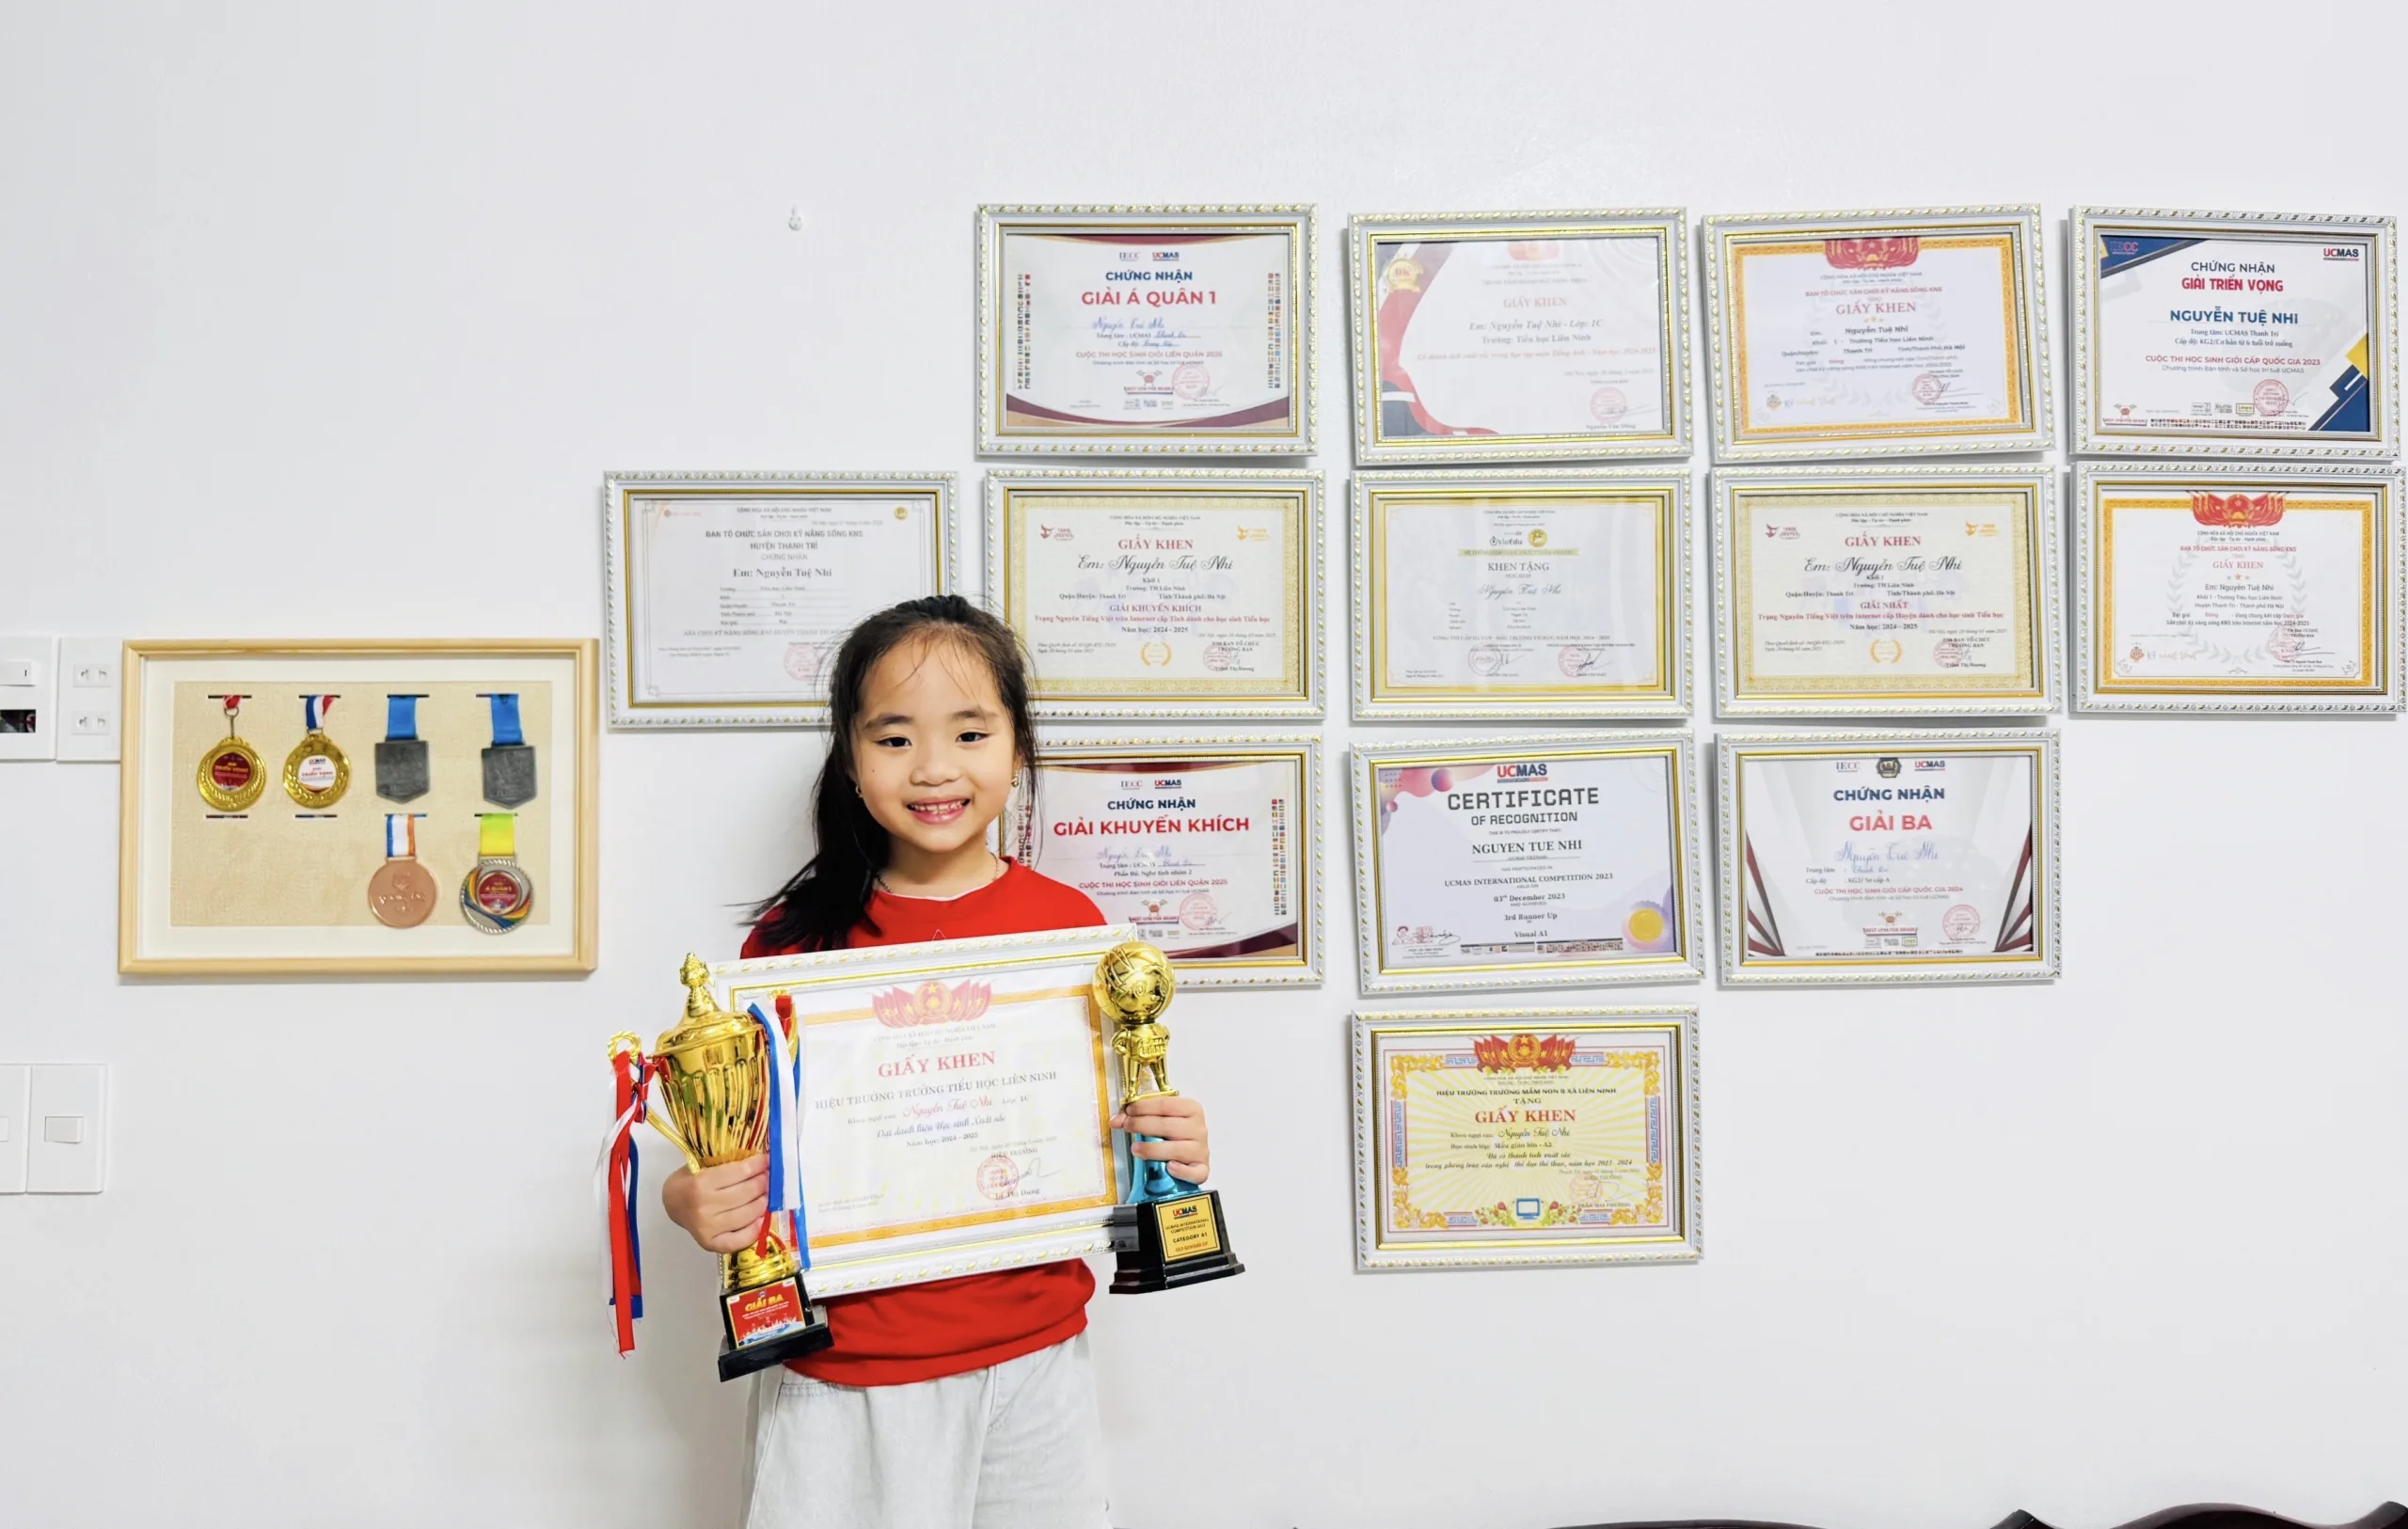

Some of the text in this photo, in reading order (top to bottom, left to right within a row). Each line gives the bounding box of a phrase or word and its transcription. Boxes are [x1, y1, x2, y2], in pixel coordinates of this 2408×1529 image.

[2322, 247, 2359, 259] UCMAS
[2191, 260, 2275, 276] CHỨNG NHẬN
[1105, 269, 1193, 284] CHỨNG NHẬN
[2181, 275, 2284, 294] GIẢI TRIỂN VỌNG
[1081, 287, 1216, 307] GIẢI Á QUÂN 1
[1835, 301, 1916, 315] GIẤY KHEN
[2170, 307, 2298, 326] NGUYỄN TUỆ NHI
[1117, 534, 1193, 550] GIẤY KHEN
[1845, 531, 1921, 547] GIẤY KHEN
[1078, 555, 1233, 575] Em: Nguyễn Tuệ Nhi
[1488, 561, 1549, 573] KHEN TẶNG
[1804, 556, 1962, 576] Em: Nguyễn Tuệ Nhi
[2212, 559, 2234, 569] GIẤY
[1497, 764, 1548, 778] UCMAS
[1915, 760, 1945, 768] UCMAS
[1154, 779, 1182, 787] UCMAS
[1448, 787, 1599, 811] CERTIFICATE
[1833, 785, 1945, 803] CHỨNG NHẬN
[1107, 796, 1196, 812] CHỨNG NHẬN
[1054, 814, 1249, 837] GIẢI KHUYẾN KHÍCH
[1471, 812, 1577, 826] OF RECOGNITION
[1849, 810, 1933, 832] GIẢI BA
[1472, 840, 1582, 855] NGUYEN TUE NHI
[1474, 876, 1537, 885] INTERNATIONAL
[1538, 874, 1593, 882] COMPETITION
[879, 1051, 994, 1078] GIẤY KHEN
[1475, 1106, 1576, 1124] GIẤY KHEN
[1173, 1206, 1197, 1216] UCMAS
[1172, 1234, 1199, 1243] CATEGORY
